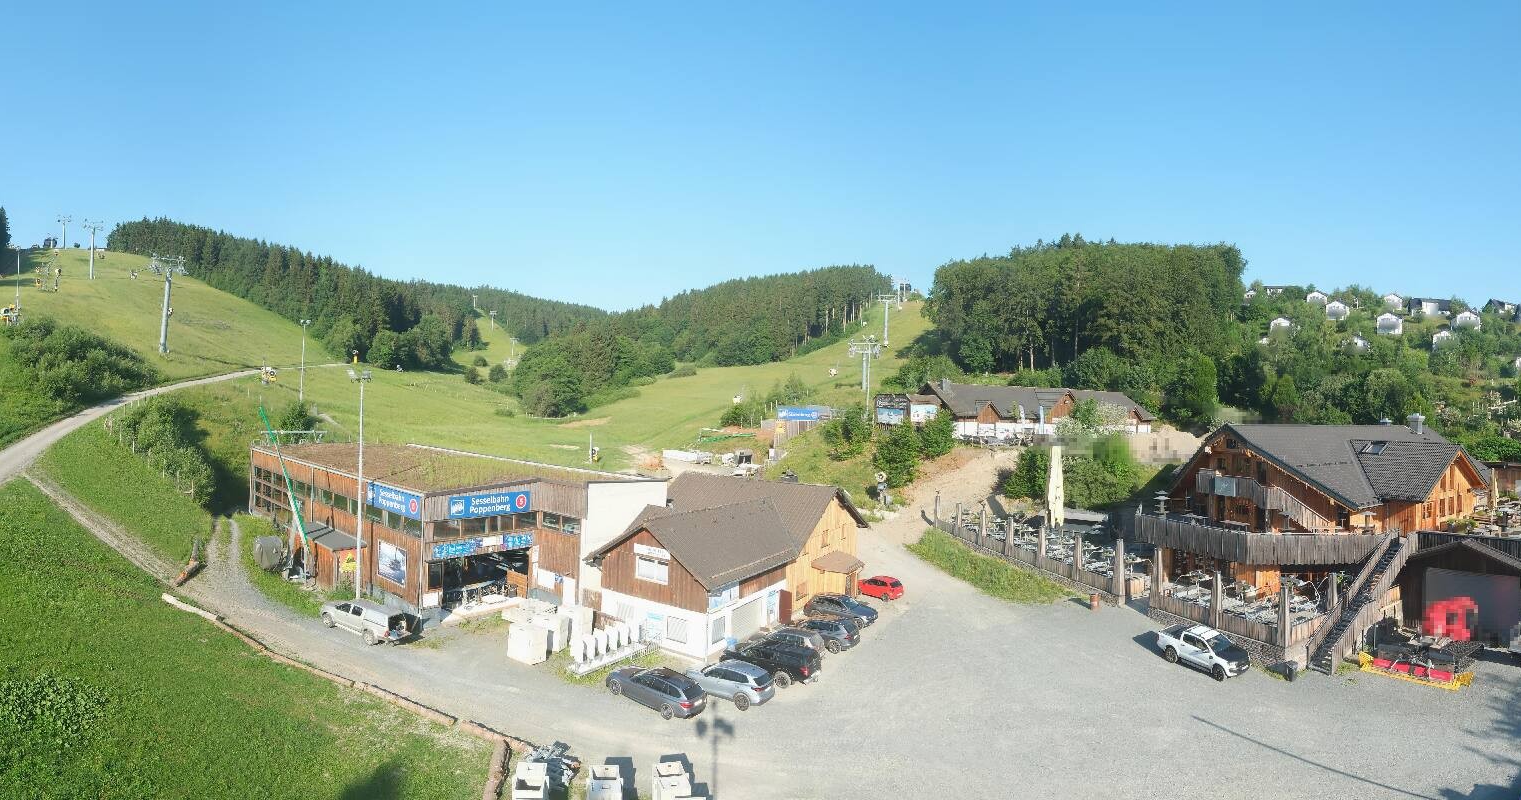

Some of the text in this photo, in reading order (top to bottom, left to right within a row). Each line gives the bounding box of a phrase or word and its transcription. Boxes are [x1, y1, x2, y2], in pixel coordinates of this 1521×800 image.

[380, 488, 405, 502] Sesselbahn
[471, 495, 510, 505] Sesselbahn
[469, 503, 511, 514] Poppenberg
